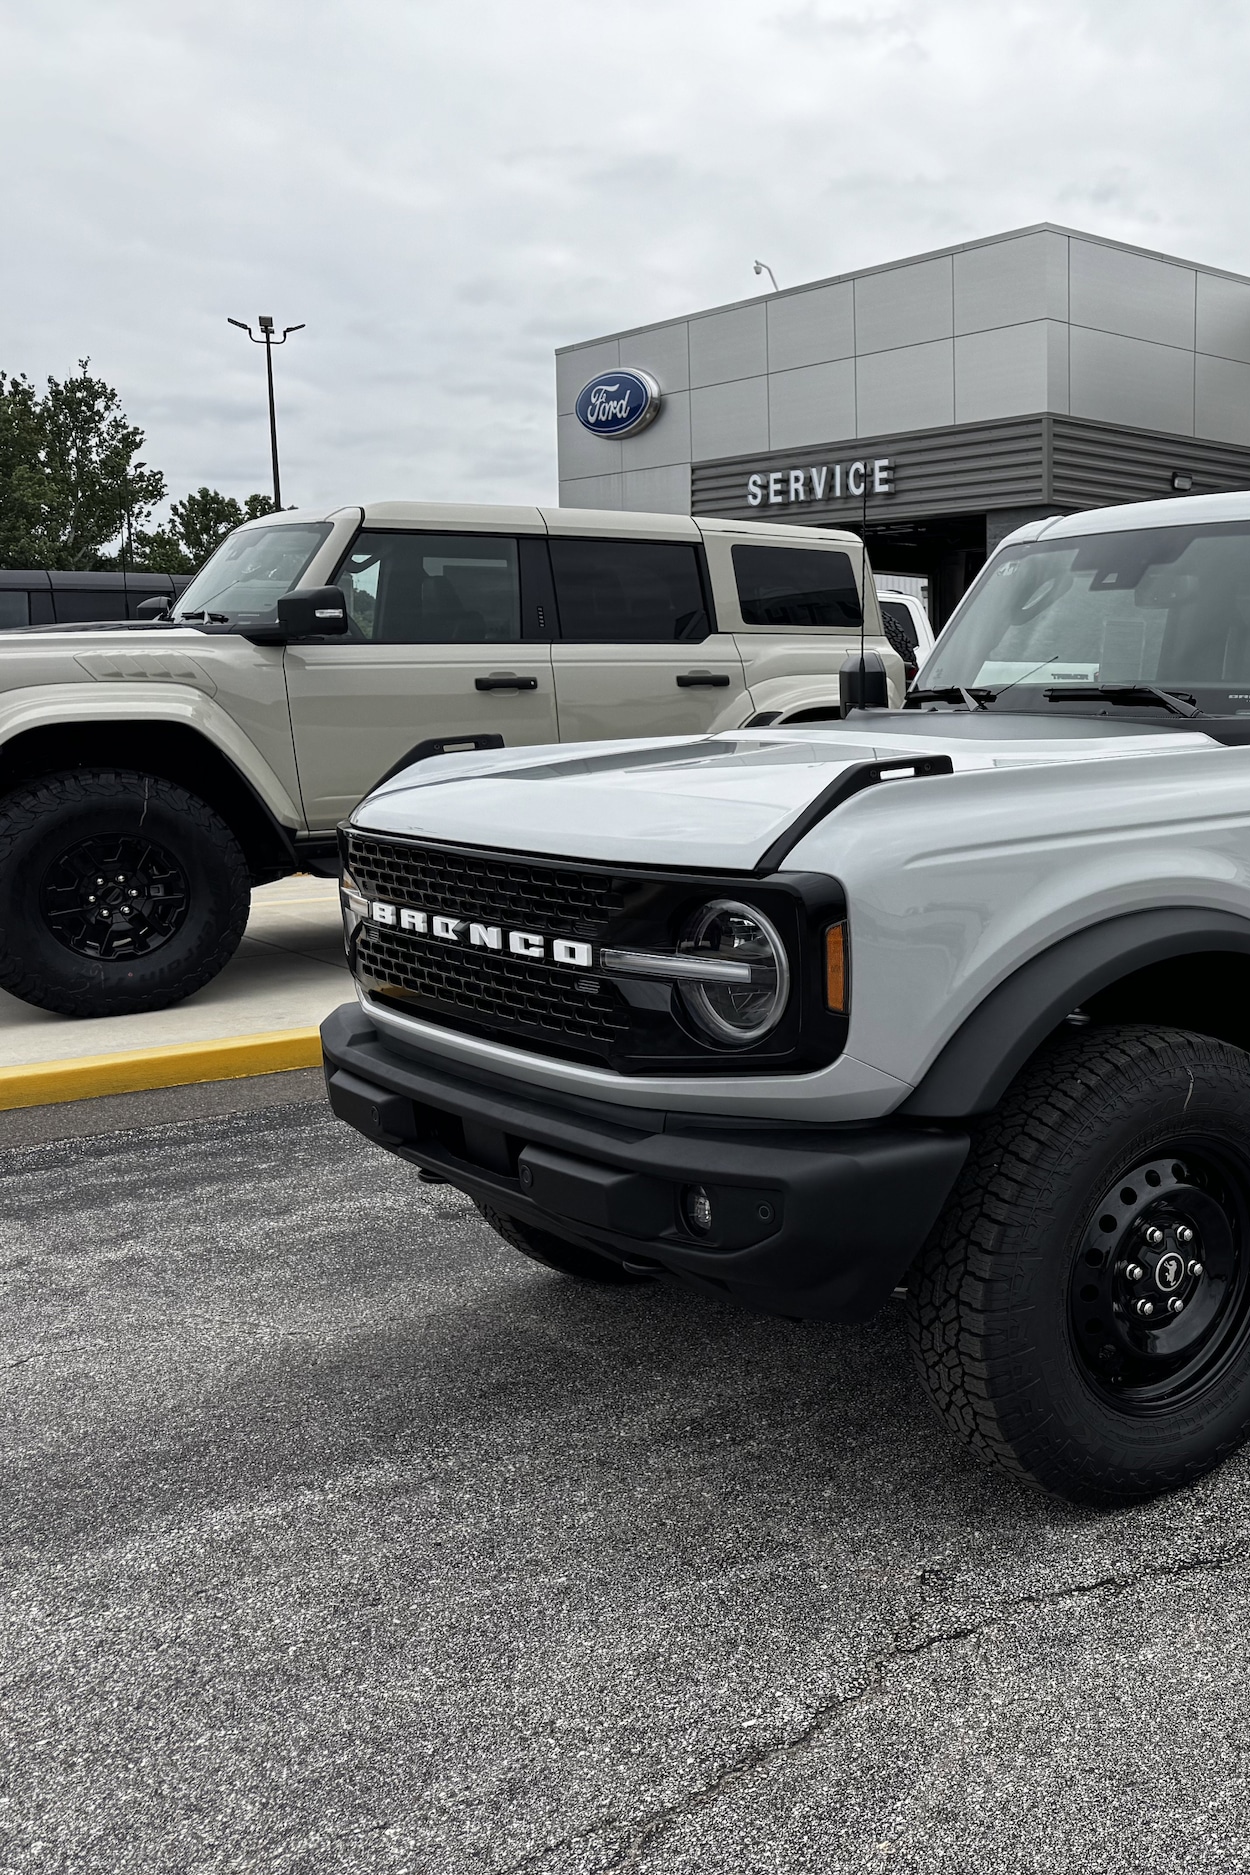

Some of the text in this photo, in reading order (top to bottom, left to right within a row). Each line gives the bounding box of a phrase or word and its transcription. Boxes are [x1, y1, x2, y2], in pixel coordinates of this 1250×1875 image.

[587, 383, 631, 424] Ford
[747, 458, 891, 506] SERVICE
[372, 901, 593, 967] BRONCO
